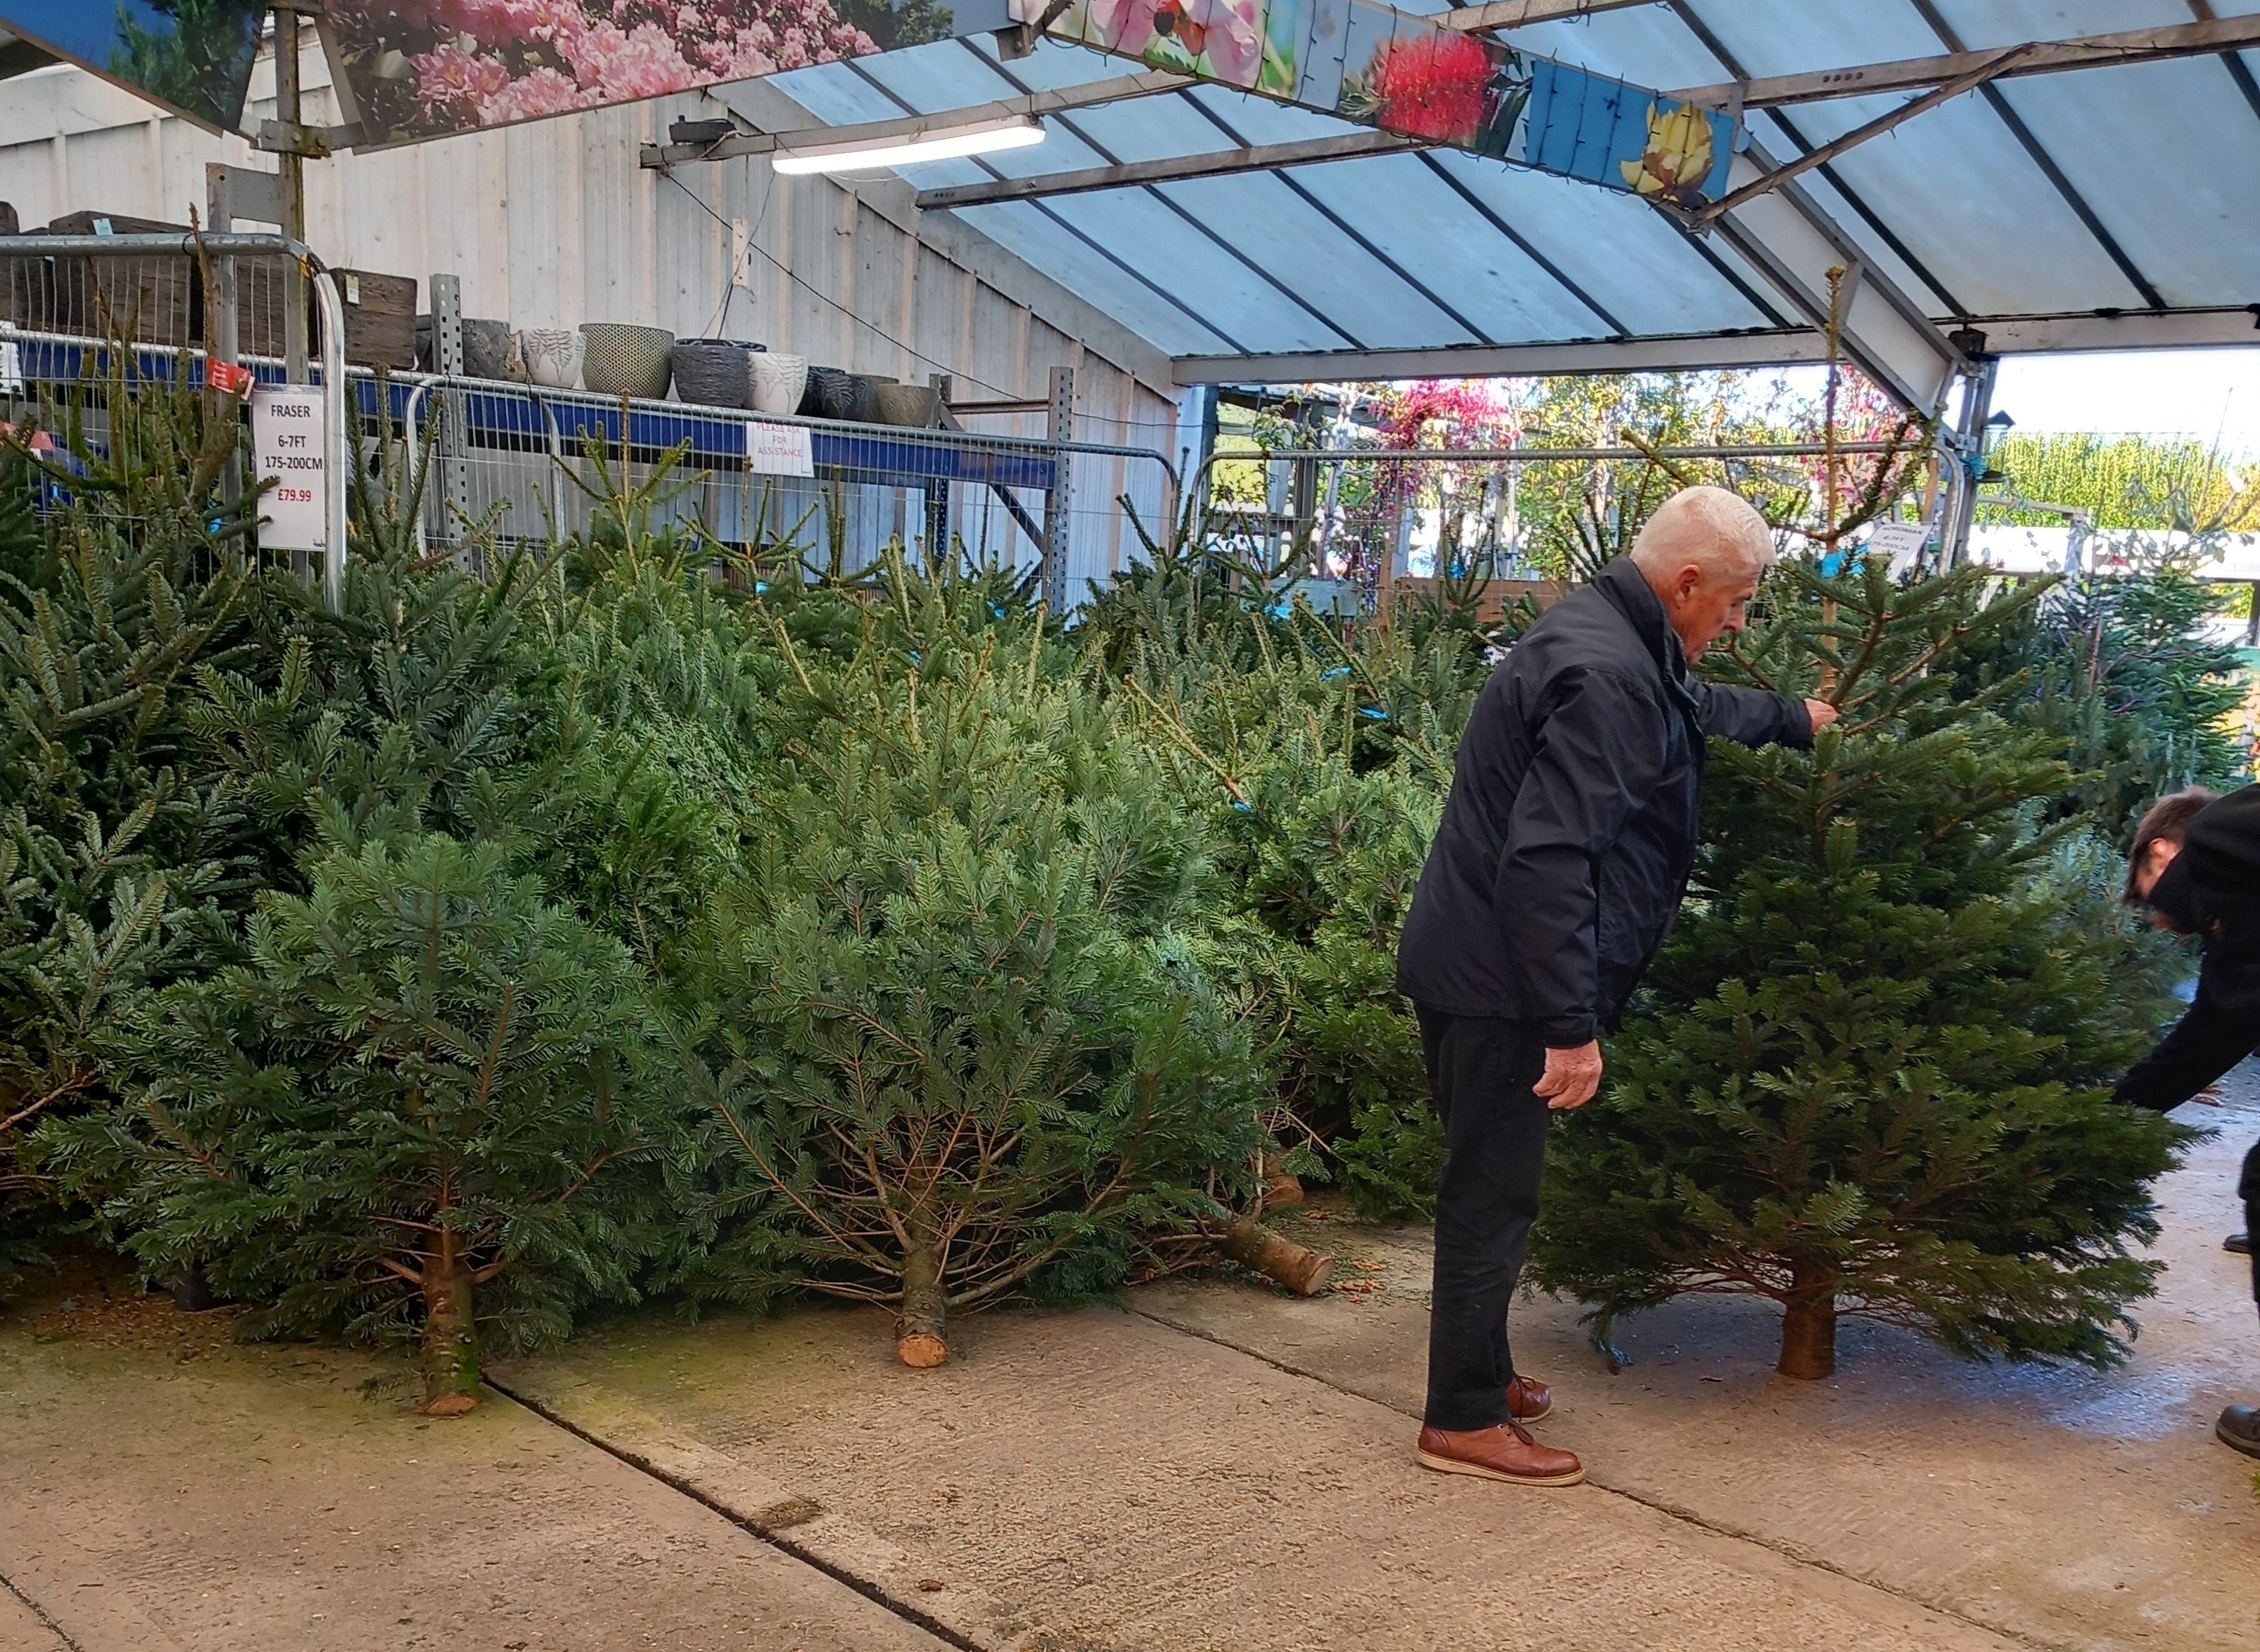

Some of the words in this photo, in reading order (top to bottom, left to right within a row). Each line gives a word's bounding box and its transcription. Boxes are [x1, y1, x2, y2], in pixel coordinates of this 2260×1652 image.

[271, 405, 310, 417] FRASER
[787, 425, 801, 434] ASK
[278, 434, 307, 448] 6-7FT
[773, 436, 787, 444] FOR
[758, 447, 803, 457] ASSISTANCE
[265, 456, 323, 470] 175-200CM
[278, 488, 312, 501] £79.99
